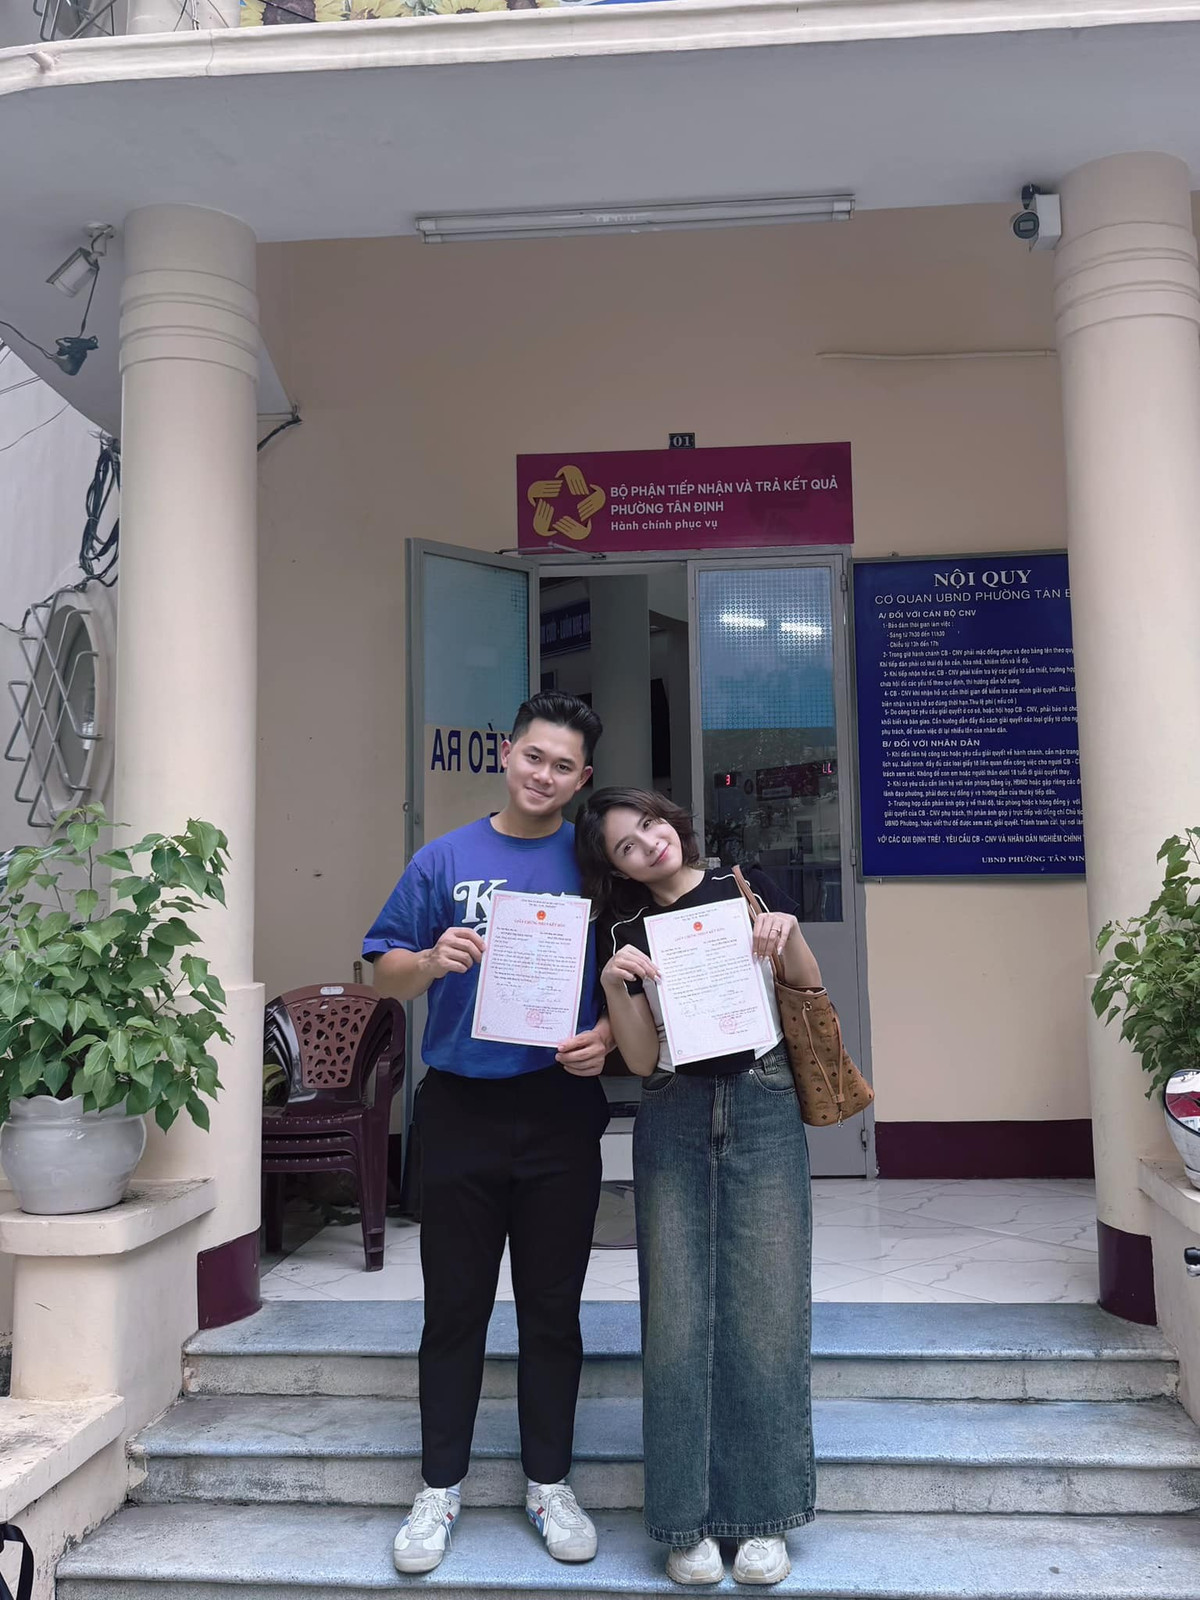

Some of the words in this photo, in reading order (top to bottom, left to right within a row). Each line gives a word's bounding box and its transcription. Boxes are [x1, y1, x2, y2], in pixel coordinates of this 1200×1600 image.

[673, 436, 690, 447] 01
[610, 484, 628, 500] BỘ
[631, 483, 665, 499] PHẬN
[668, 479, 695, 495] TIẾP
[698, 480, 733, 496] NHẬN
[736, 479, 753, 493] VÀ
[755, 477, 781, 492] TRẢ
[784, 475, 808, 491] KẾT
[810, 475, 838, 490] QUẢ
[610, 501, 664, 515] PHƯỜNG
[666, 500, 691, 513] TÂN
[694, 501, 724, 515] ĐỊNH
[611, 521, 639, 531] Hành
[642, 520, 672, 530] chính
[675, 519, 702, 531] phục
[705, 520, 718, 530] vụ
[933, 567, 975, 589] NỘI
[981, 568, 1032, 588] QUY
